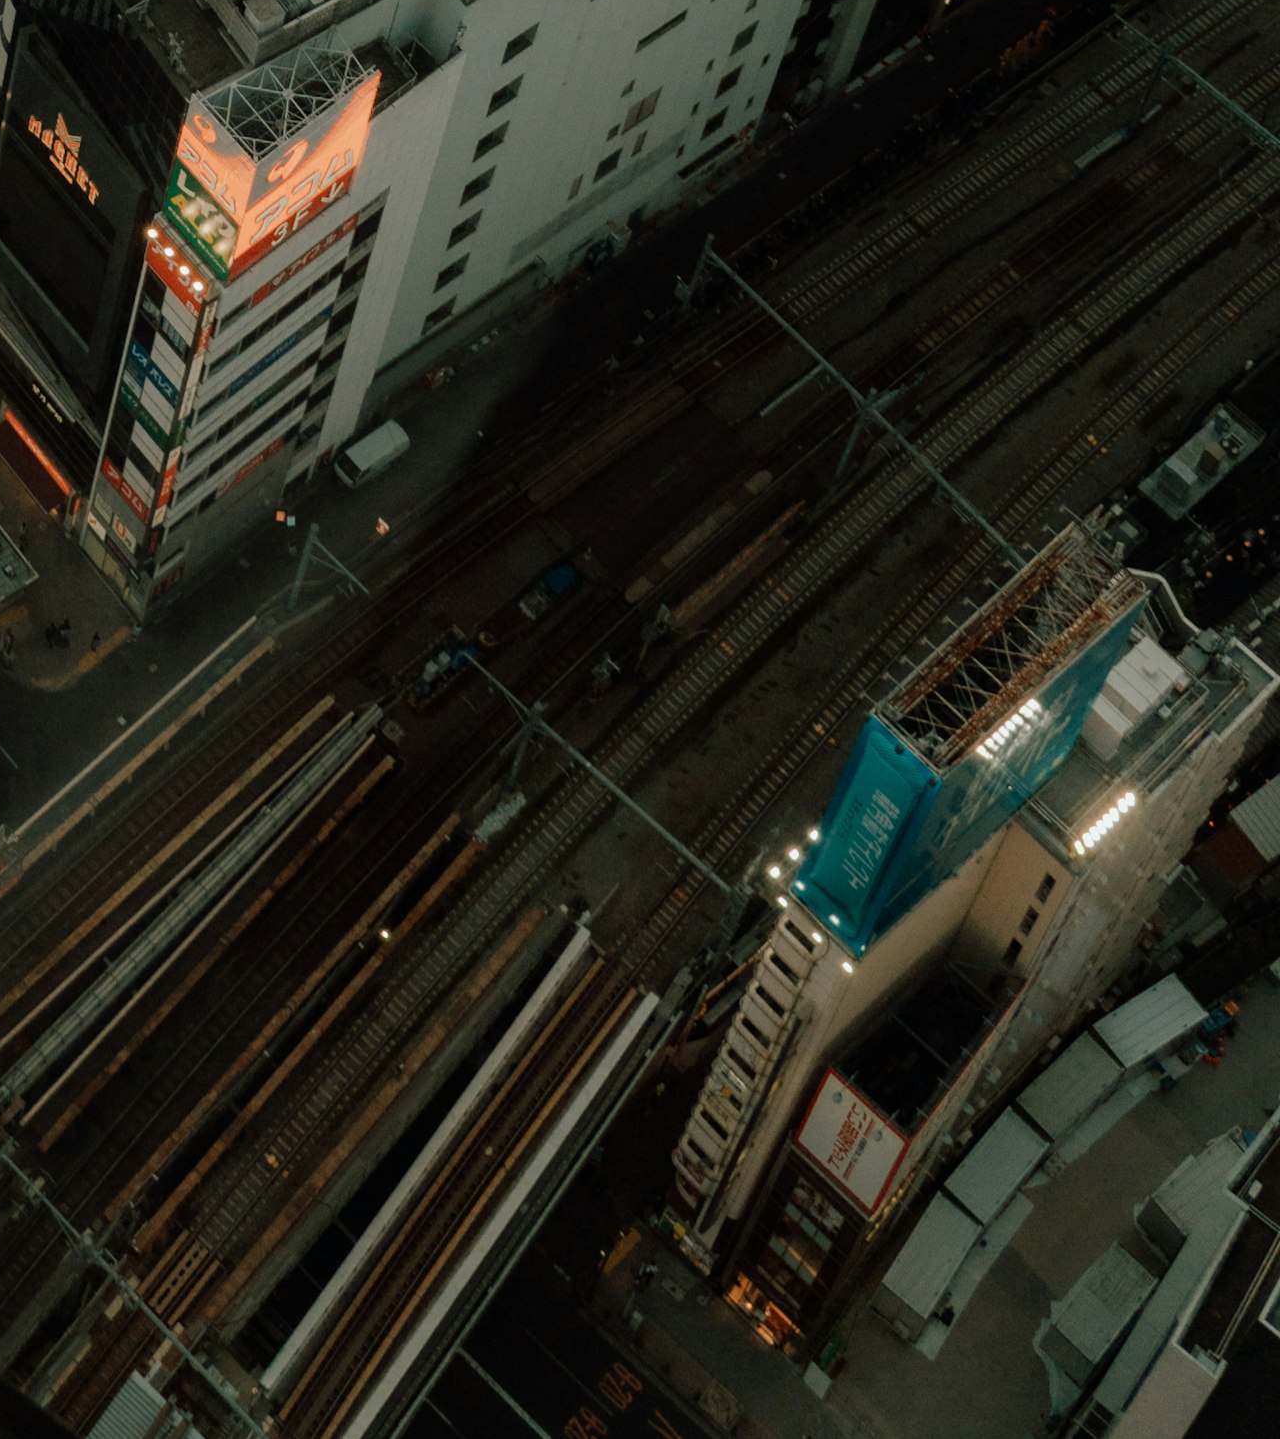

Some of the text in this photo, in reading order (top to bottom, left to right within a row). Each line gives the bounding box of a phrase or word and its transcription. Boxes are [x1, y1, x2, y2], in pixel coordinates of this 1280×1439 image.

[27, 114, 99, 207] MAGNET
[176, 141, 236, 219] アコム
[250, 151, 354, 245] アコム
[271, 210, 308, 248] 3F
[108, 466, 144, 515] アコム
